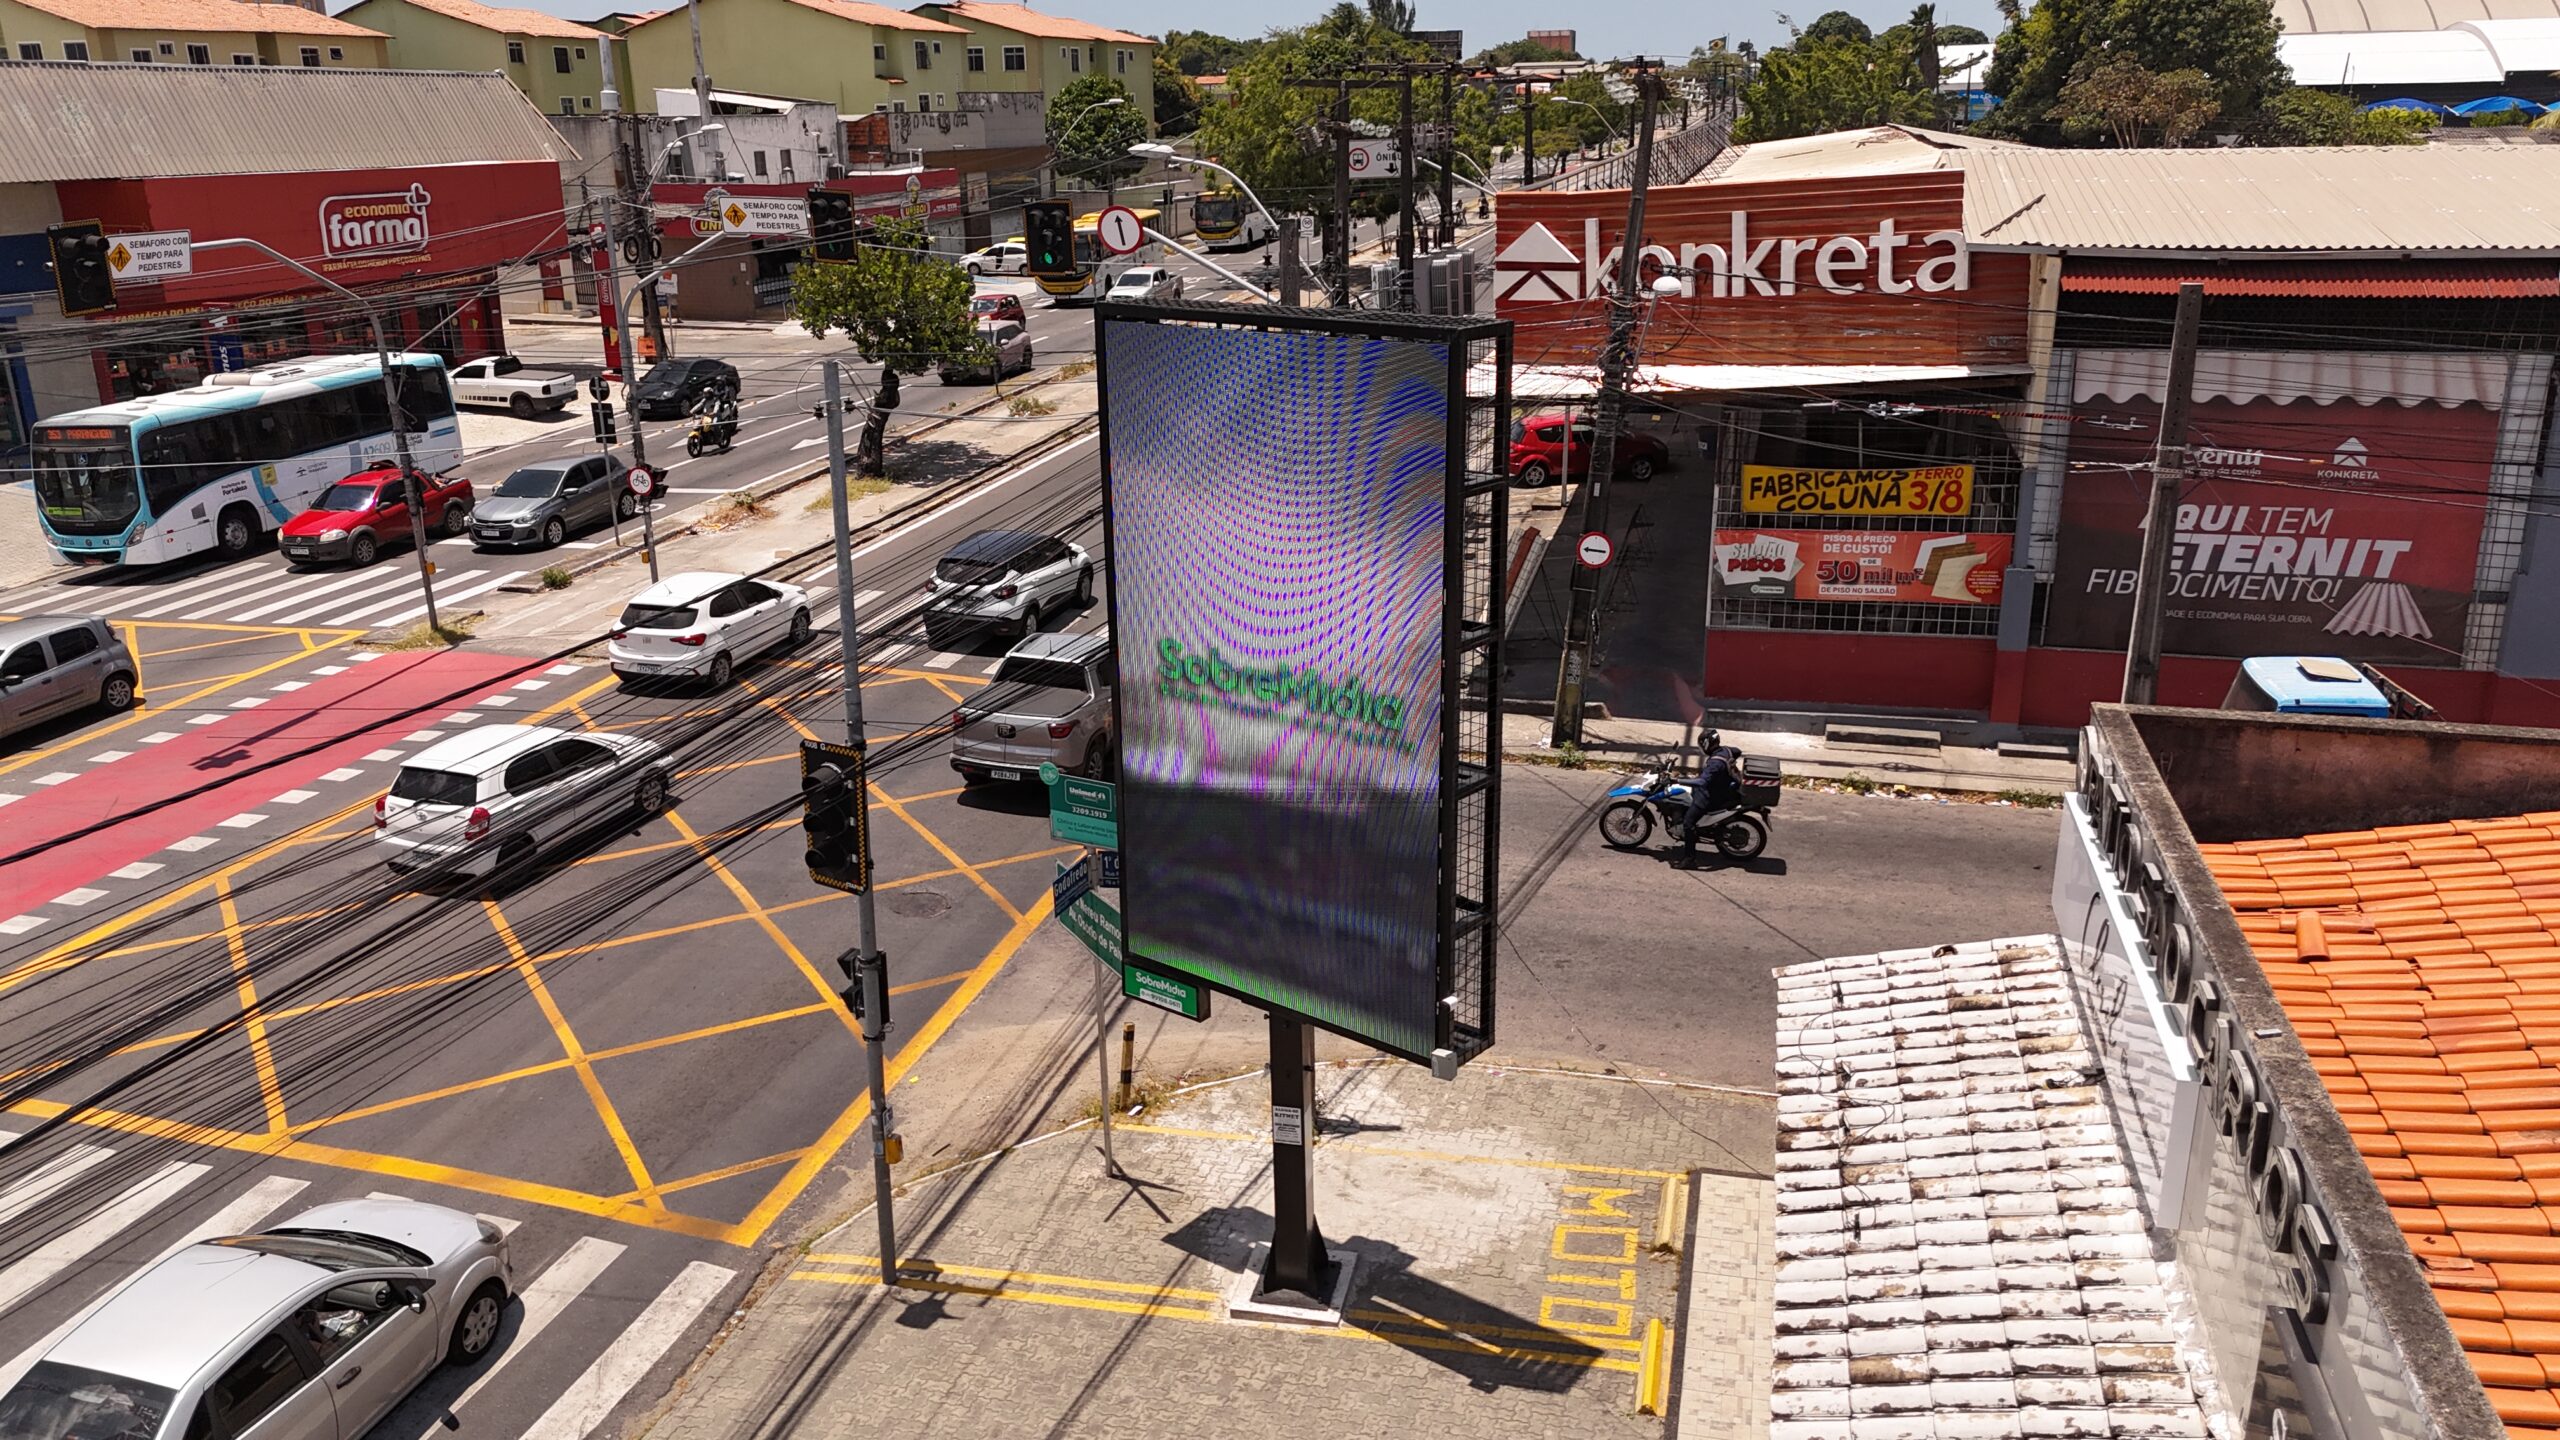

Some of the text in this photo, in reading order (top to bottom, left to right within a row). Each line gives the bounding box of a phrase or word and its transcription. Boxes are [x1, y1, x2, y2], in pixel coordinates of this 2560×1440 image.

[344, 203, 410, 218] economia
[743, 201, 804, 211] SEMÁFORO COM
[751, 211, 799, 220] TEMPO PARA
[329, 213, 421, 248] farma
[756, 222, 800, 230] PEDESTRES
[130, 236, 188, 249] SEMÁFORO COM
[137, 249, 183, 260] TEMPO PARA
[1586, 211, 1970, 298] konkreta
[138, 261, 182, 272] PEDESTRES
[2317, 470, 2380, 480] KONKRETA
[1750, 467, 1964, 500] FABRICAMOS FERRO
[1776, 479, 1964, 513] COLUNA 3/8
[2259, 506, 2334, 535] TEM
[1823, 534, 1853, 542] PISOS
[1863, 535, 1896, 544] PREÇO
[1823, 543, 1892, 554] DE CUSTO!
[2170, 532, 2413, 579] ETERNIT
[1727, 558, 1787, 573] PISOS
[1816, 560, 1859, 583] 50
[1863, 567, 1892, 583] mil
[1832, 586, 1850, 594] PISO
[1864, 586, 1896, 595] SALDÃO
[2196, 610, 2241, 620] ECONOMIA
[2243, 613, 2266, 622] PARA
[2268, 614, 2286, 622] SUA
[2287, 614, 2312, 624] OBRA
[1069, 786, 1097, 798] Unimed
[1071, 805, 1108, 819] 3209.1919
[1055, 862, 1088, 897] Godofredo
[1135, 971, 1187, 999] SobreMidia
[1539, 1185, 1641, 1336] MOTO
